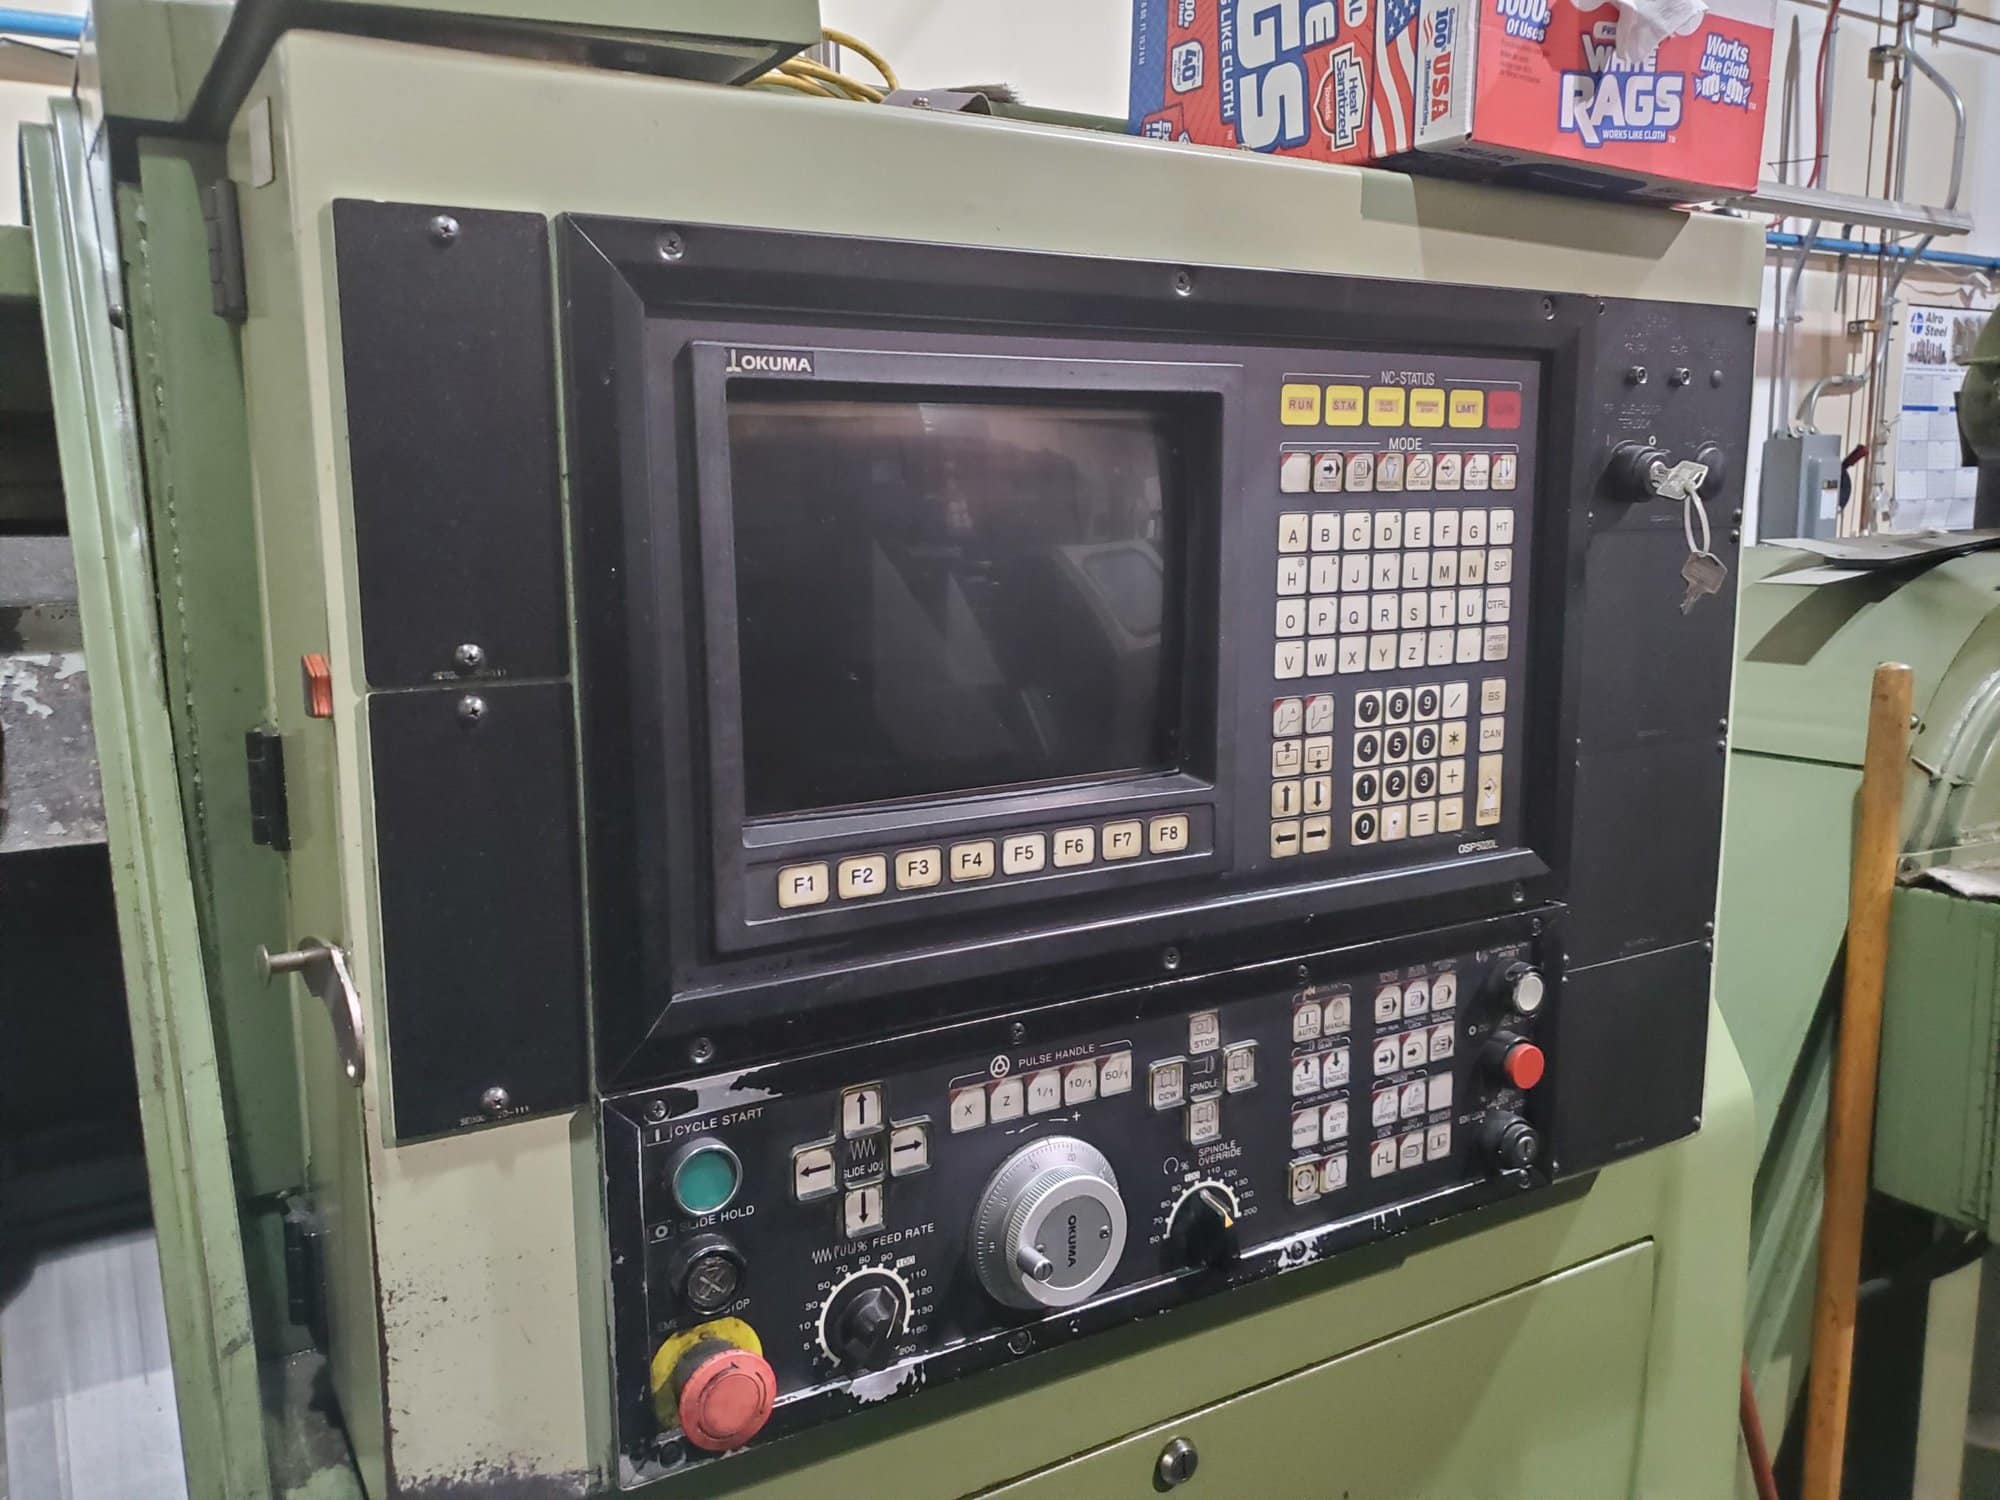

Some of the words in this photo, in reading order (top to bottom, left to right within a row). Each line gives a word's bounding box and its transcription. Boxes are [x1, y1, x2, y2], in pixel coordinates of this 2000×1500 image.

[1221, 8, 1232, 52] LIKE
[1507, 18, 1519, 35] Of
[1520, 22, 1545, 41] Uses
[1707, 35, 1748, 63] Works
[1701, 56, 1722, 73] Like
[1723, 61, 1749, 79] Cloth
[1222, 56, 1234, 117] CLOTH
[1431, 51, 1451, 122] USA
[1336, 59, 1348, 141] Sanitized
[1349, 77, 1358, 116] Heat
[1561, 74, 1683, 144] RAGS
[1603, 130, 1627, 140] WORKS
[1628, 130, 1644, 140] LIKE
[1645, 130, 1666, 140] CLOTH
[1925, 312, 1944, 323] Alro
[1925, 325, 1948, 337] Steel
[741, 355, 812, 372] OKUMA
[1381, 371, 1435, 386] NC-STATUS
[1288, 400, 1313, 411] RUN
[1389, 438, 1422, 450] MODE
[1288, 529, 1298, 544] A
[1321, 528, 1330, 542] B
[1352, 528, 1361, 542] C
[1384, 527, 1393, 541] D
[1414, 526, 1421, 540] E
[1442, 525, 1450, 539] F
[1469, 525, 1479, 539] G
[1288, 572, 1296, 586] H
[1351, 570, 1360, 584] J
[1382, 568, 1391, 582] K
[1411, 567, 1418, 581] L
[1439, 566, 1450, 580] M
[1468, 565, 1477, 578] N
[1494, 560, 1507, 571] SP
[1318, 613, 1327, 627] P
[1349, 611, 1358, 625] Q
[1381, 609, 1390, 623] R
[1409, 608, 1418, 621] S
[1440, 605, 1447, 619] T
[1467, 604, 1474, 617] U
[1284, 656, 1294, 671] V
[1315, 653, 1327, 667] W
[1348, 652, 1357, 665] X
[1379, 649, 1388, 662] Y
[1408, 647, 1416, 661] Z
[1365, 702, 1374, 716] 7
[1395, 699, 1403, 713] 8
[1423, 695, 1432, 710] 9
[1363, 741, 1372, 755] 4
[1393, 738, 1401, 752] 5
[1421, 734, 1430, 749] 6
[1483, 728, 1501, 739] CAN
[1362, 780, 1369, 795] 1
[1392, 776, 1400, 791] 2
[1420, 773, 1428, 787] 3
[1361, 819, 1369, 834] 0
[794, 877, 815, 894] F1
[851, 868, 873, 885] F2
[908, 860, 929, 876] F3
[961, 852, 983, 869] F4
[1014, 845, 1034, 862] F5
[1064, 838, 1084, 854] F6
[1113, 832, 1132, 847] F7
[1160, 826, 1178, 841] F8
[1298, 1026, 1318, 1036] AUTO
[1194, 1038, 1216, 1049] STOP
[1018, 1055, 1052, 1068] PULSE
[1055, 1044, 1095, 1060] HANDLE
[964, 1105, 972, 1116] X
[1003, 1096, 1010, 1107] Z
[1037, 1087, 1054, 1097] 1/1
[1069, 1077, 1092, 1088] 10/1
[1105, 1070, 1129, 1081] 50/1
[674, 1121, 718, 1136] CYCLE
[722, 1107, 764, 1126] START
[1198, 1139, 1236, 1158] SPINDLE
[1198, 1147, 1242, 1166] OVERRIDE
[1207, 1166, 1220, 1175] 110
[1224, 1168, 1238, 1177] 120
[720, 1205, 755, 1222] HOLD
[1244, 1207, 1258, 1216] 200
[873, 1232, 902, 1248] FEED
[905, 1223, 935, 1239] RATE
[1068, 1215, 1077, 1268] OKUMA
[859, 1255, 871, 1264] 80
[880, 1253, 893, 1262] 90
[835, 1265, 848, 1275] 70
[911, 1269, 927, 1279] 110
[916, 1287, 933, 1296] 120
[805, 1302, 818, 1311] 30
[917, 1305, 933, 1315] 130
[799, 1322, 811, 1331] 10
[899, 1345, 917, 1356] 200
